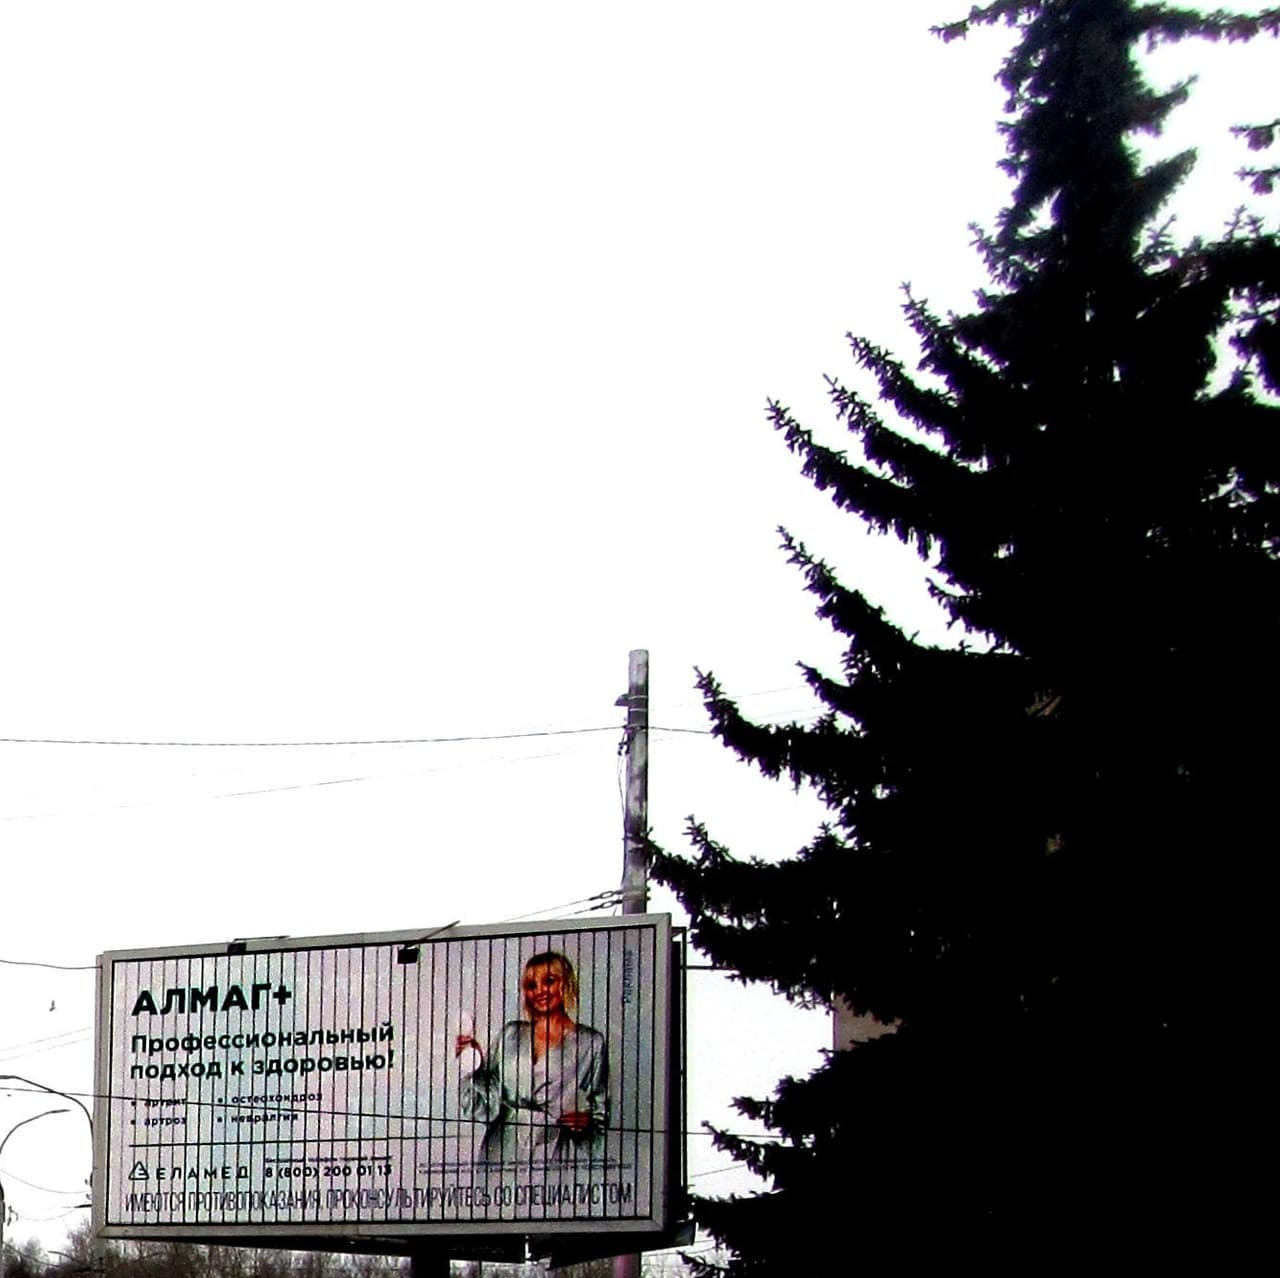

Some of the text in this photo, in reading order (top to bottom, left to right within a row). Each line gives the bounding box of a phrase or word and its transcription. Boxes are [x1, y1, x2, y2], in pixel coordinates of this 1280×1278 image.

[131, 982, 292, 1016] АЛМАГ+
[131, 1023, 394, 1056] Профессиональный
[130, 1050, 395, 1082] подход к здоровью!
[144, 1116, 187, 1127] артроз
[156, 1165, 249, 1180] ЕЛАМЕД
[265, 1167, 273, 1178] 8
[279, 1166, 319, 1179] (800)
[323, 1166, 352, 1177] 200
[125, 1191, 185, 1212] ИМЕЮТСЯ
[326, 1184, 491, 1211] ПРОКОНСУЛЬТИРУЙТЕСЬ
[494, 1185, 513, 1207] СО
[515, 1182, 631, 1207] СПЕЦИАЛИСТОМ
